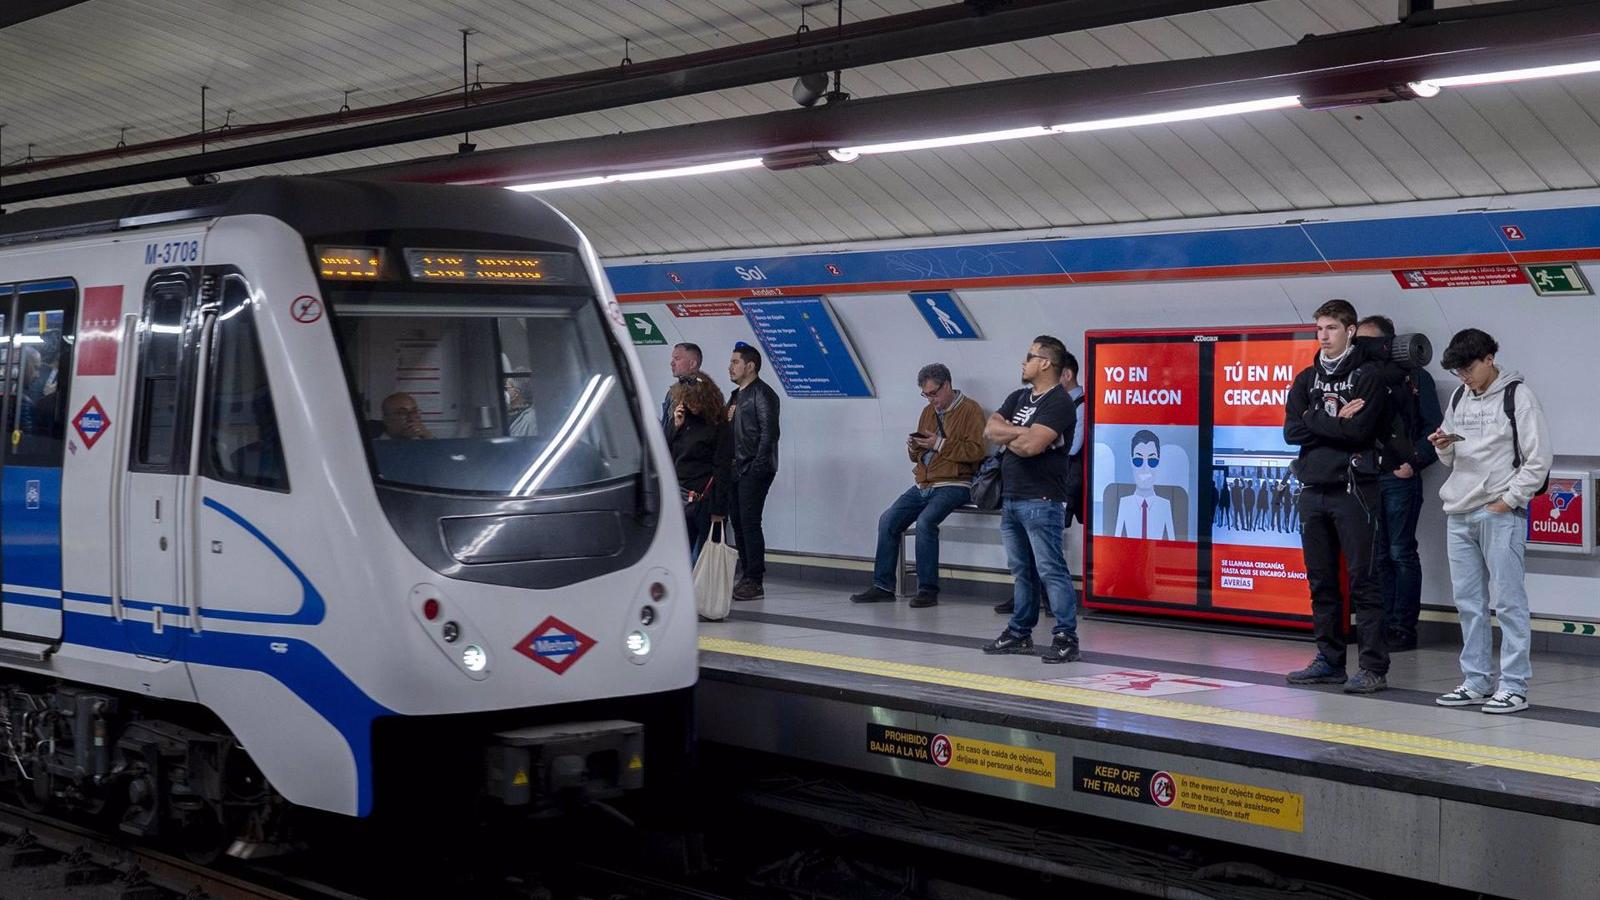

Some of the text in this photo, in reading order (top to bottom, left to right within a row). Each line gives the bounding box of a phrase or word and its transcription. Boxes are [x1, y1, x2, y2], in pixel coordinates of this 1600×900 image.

[1507, 227, 1521, 239] 2
[145, 240, 198, 265] M-3708
[671, 274, 681, 283] 2
[735, 265, 767, 280] Sol
[829, 265, 839, 276] 2
[775, 287, 784, 296] 2
[1103, 366, 1148, 382] YO EN
[1223, 360, 1294, 382] TÚ EN MI
[1103, 389, 1183, 406] MI FALCON
[1532, 517, 1580, 534] CUÍDALO
[1228, 560, 1254, 568] LLAMABA
[1254, 561, 1285, 570] CERCANÍAS
[1239, 568, 1252, 576] QUE
[1259, 569, 1287, 578] ENCARGÓ
[1222, 577, 1252, 588] AVERÍAS
[885, 729, 929, 746] PROHIBIDO
[870, 741, 928, 760] BAJAR A LA VÍA
[956, 743, 965, 751] En
[966, 746, 982, 754] caso
[982, 747, 990, 755] de
[1009, 751, 1018, 760] de
[1019, 753, 1045, 766] objetos,
[980, 758, 986, 766] al
[987, 760, 1014, 772] personal
[1015, 765, 1024, 773] de
[1025, 766, 1052, 778] estación
[1095, 765, 1141, 782] KEEP OFF
[1083, 777, 1141, 798] THE TRACKS
[1181, 779, 1285, 804] In the event of objects dropped
[1180, 790, 1281, 815] on the tracks, seek assistance
[1181, 800, 1250, 820] from the station staff
